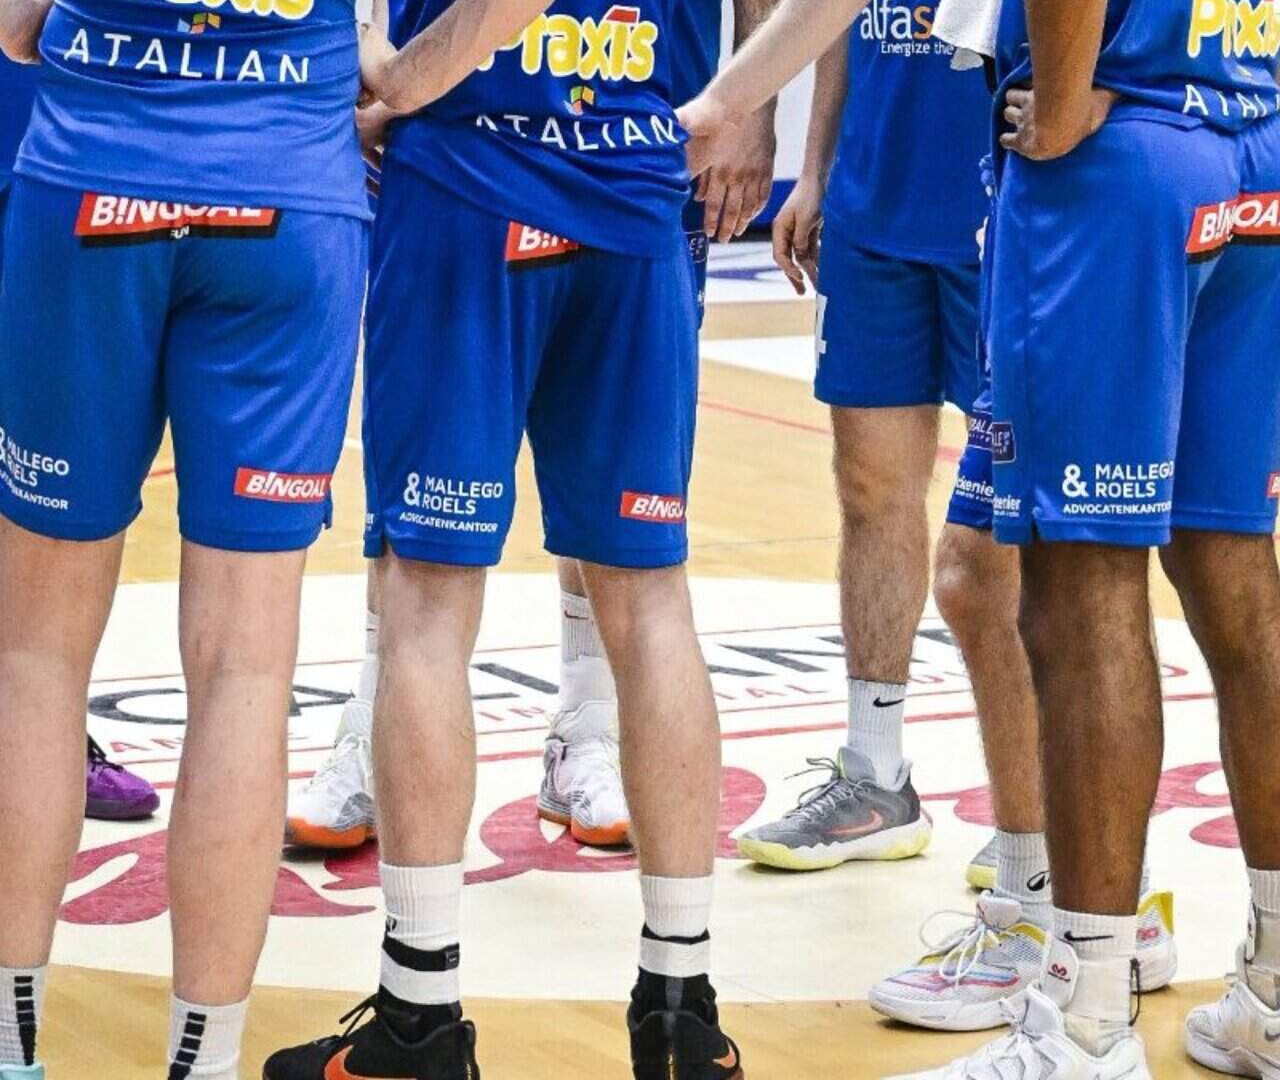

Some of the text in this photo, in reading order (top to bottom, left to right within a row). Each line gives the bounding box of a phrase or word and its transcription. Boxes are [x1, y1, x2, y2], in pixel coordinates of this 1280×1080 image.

[64, 27, 310, 84] ATALIAN
[881, 41, 930, 57] Energize
[404, 472, 503, 507] & MALLEGO
[1062, 463, 1089, 497] &
[1095, 481, 1156, 498] ROELS
[422, 494, 476, 516] ROELS
